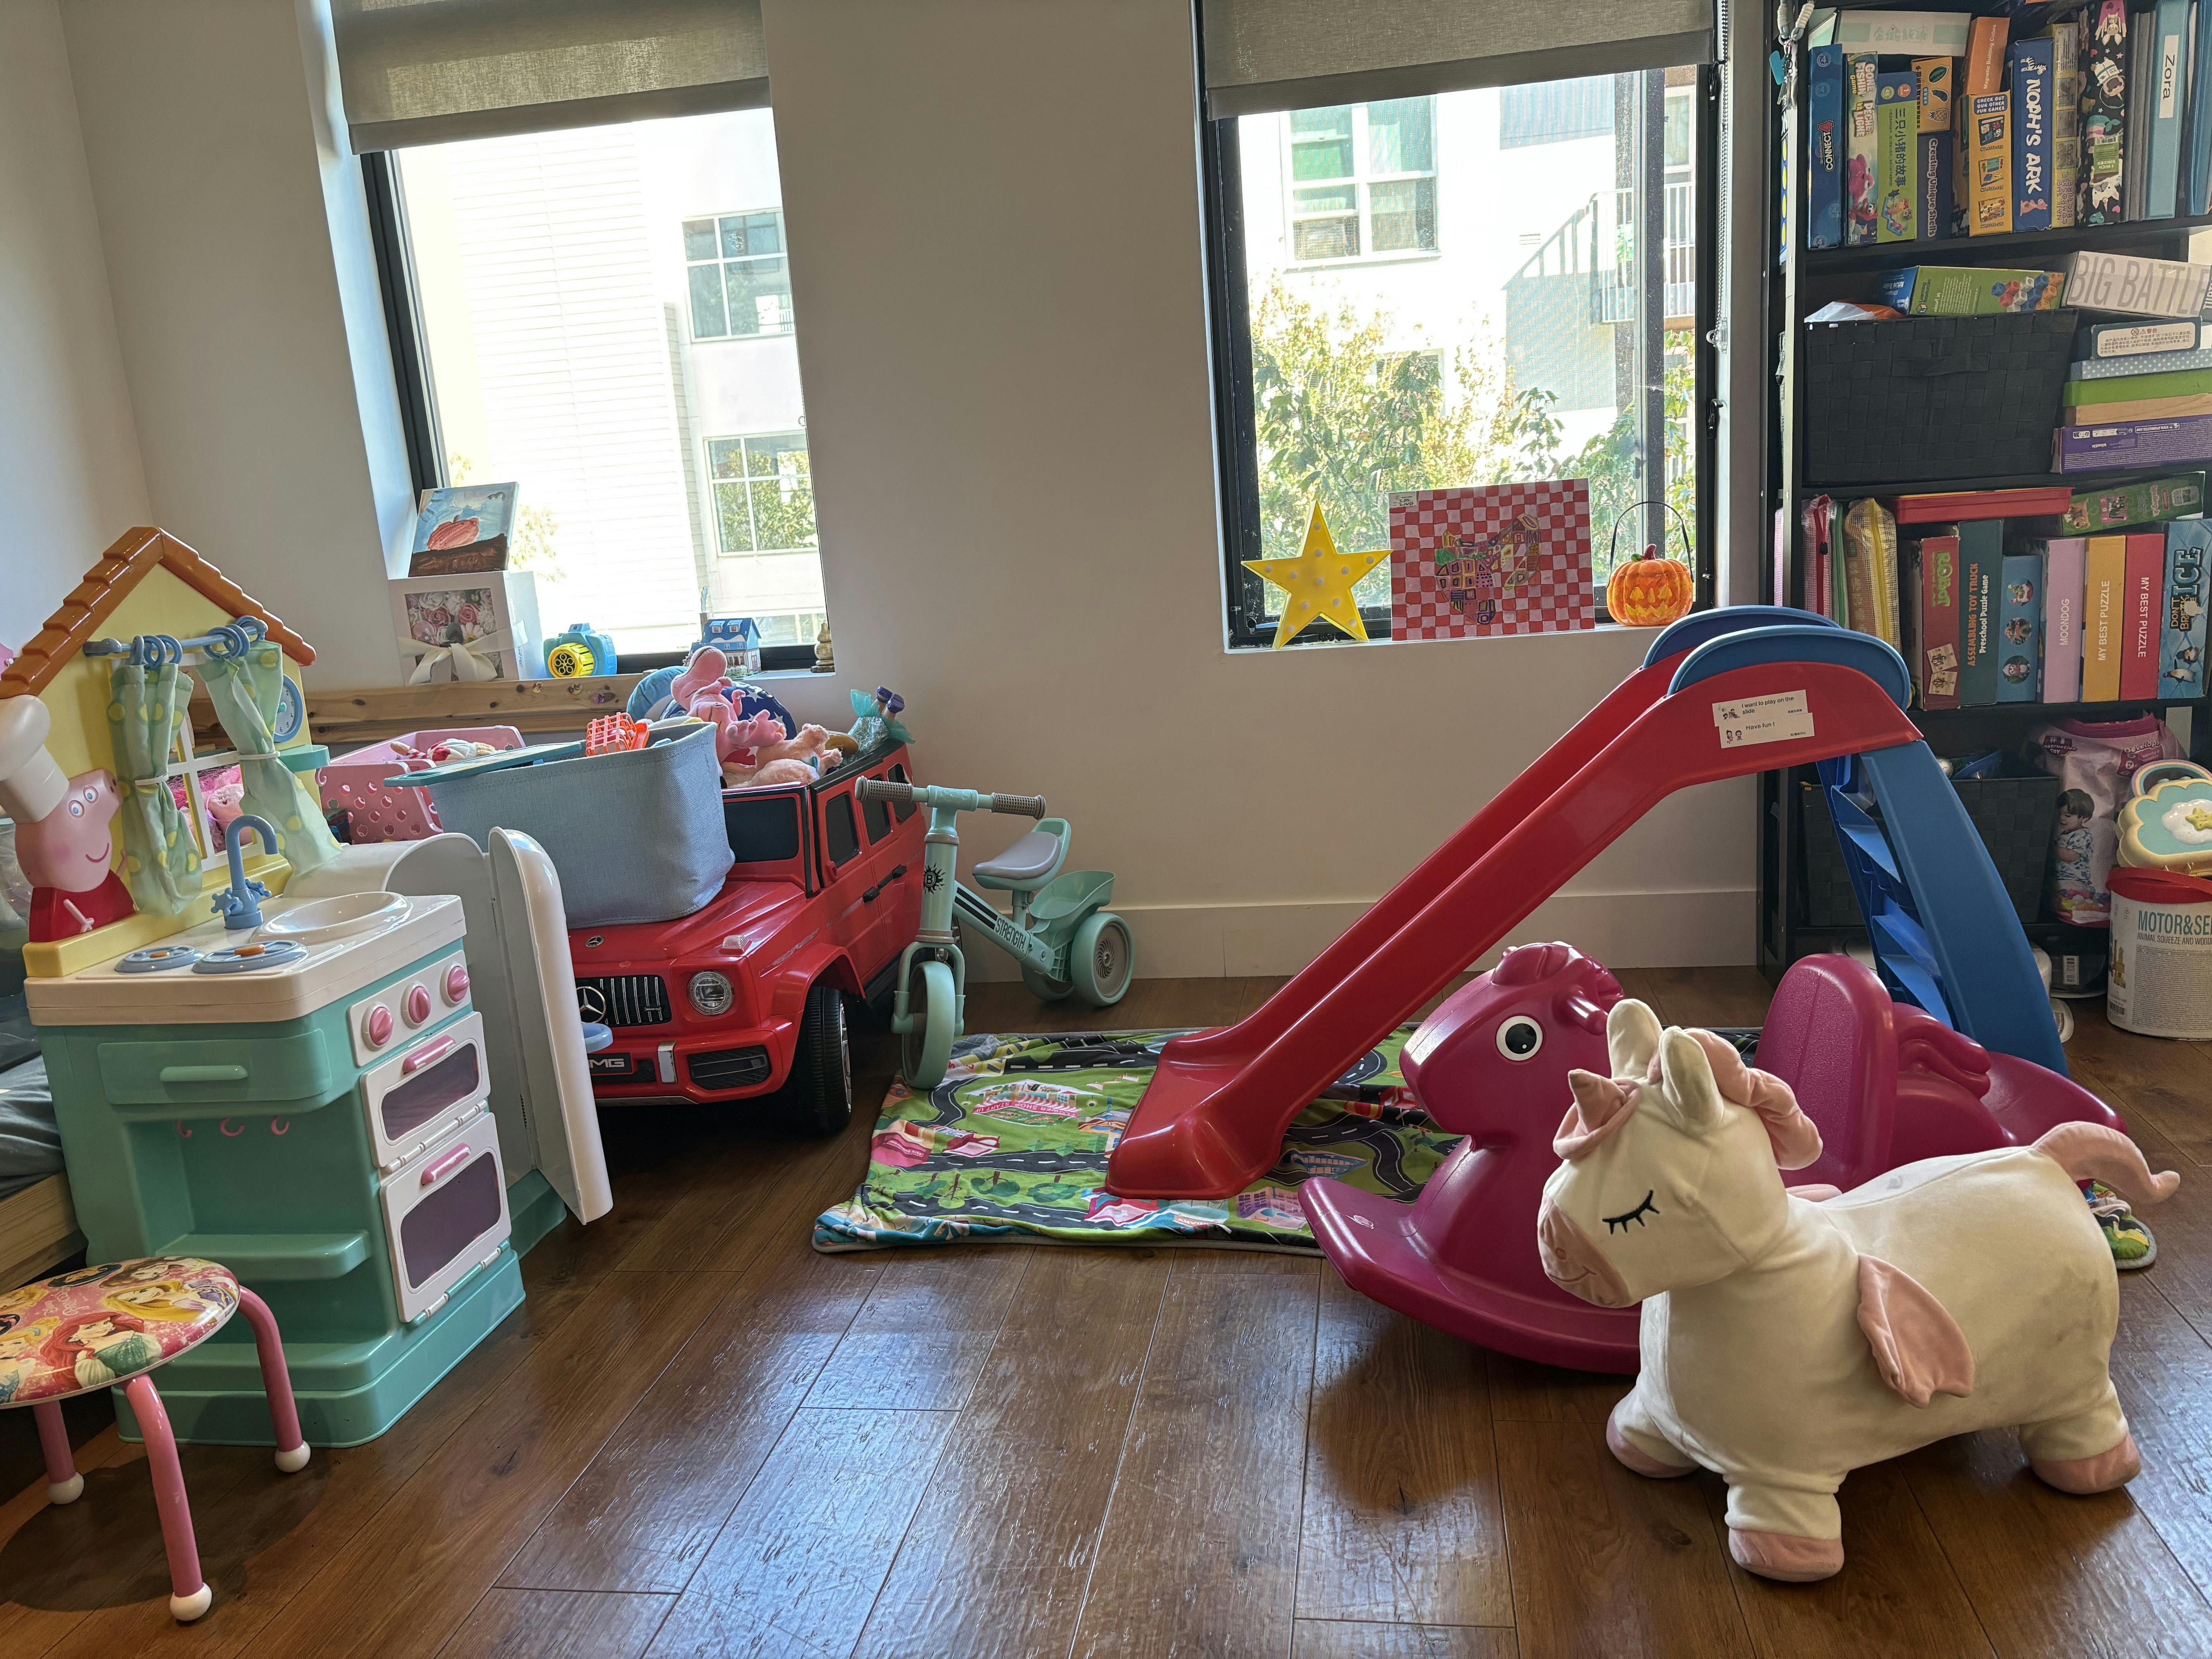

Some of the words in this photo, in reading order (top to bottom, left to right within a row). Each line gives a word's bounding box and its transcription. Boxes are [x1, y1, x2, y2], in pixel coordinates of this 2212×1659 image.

[1986, 43, 1995, 65] Building
[1865, 63, 1875, 92] GONE
[2163, 54, 2175, 100] Zora
[1817, 120, 1834, 133] 4
[1853, 110, 1865, 137] LIGNE
[2026, 79, 2042, 146] NOAH'S
[1823, 132, 1834, 171] CONNECT
[1895, 108, 1906, 187] 三只小猪的故事
[1927, 138, 1938, 178] Creating
[2026, 153, 2043, 194] ARK
[1927, 177, 1937, 209] Unique
[1928, 209, 1937, 237] Shells
[1918, 282, 1927, 303] Learning
[2068, 255, 2116, 306] BIG
[2117, 260, 2210, 315] BATTLE
[1969, 563, 1978, 593] TRUCK
[2140, 577, 2150, 591] MY
[2172, 547, 2202, 596] ICE
[1969, 594, 1977, 612] TOY
[1980, 595, 1988, 617] Puzzle
[2100, 580, 2110, 618] PUZZLE
[2140, 593, 2149, 618] BEST
[2171, 597, 2180, 628] DON'T
[1979, 617, 1987, 654] Preschool
[2059, 598, 2070, 646] MOONDOG
[2099, 620, 2108, 645] BEST
[1967, 614, 1977, 666] ASSEMBLING
[2138, 620, 2147, 658] PUZZLE
[2098, 647, 2107, 661] MY
[2124, 740, 2161, 753] Develops
[926, 874, 933, 884] B
[2137, 932, 2155, 942] ANIMAL
[2157, 935, 2181, 945] SQUEEZE
[2181, 937, 2194, 945] AND
[2195, 937, 2212, 946] WOOD
[589, 1058, 625, 1068] MG
[1014, 1102, 1038, 1111] SHOP
